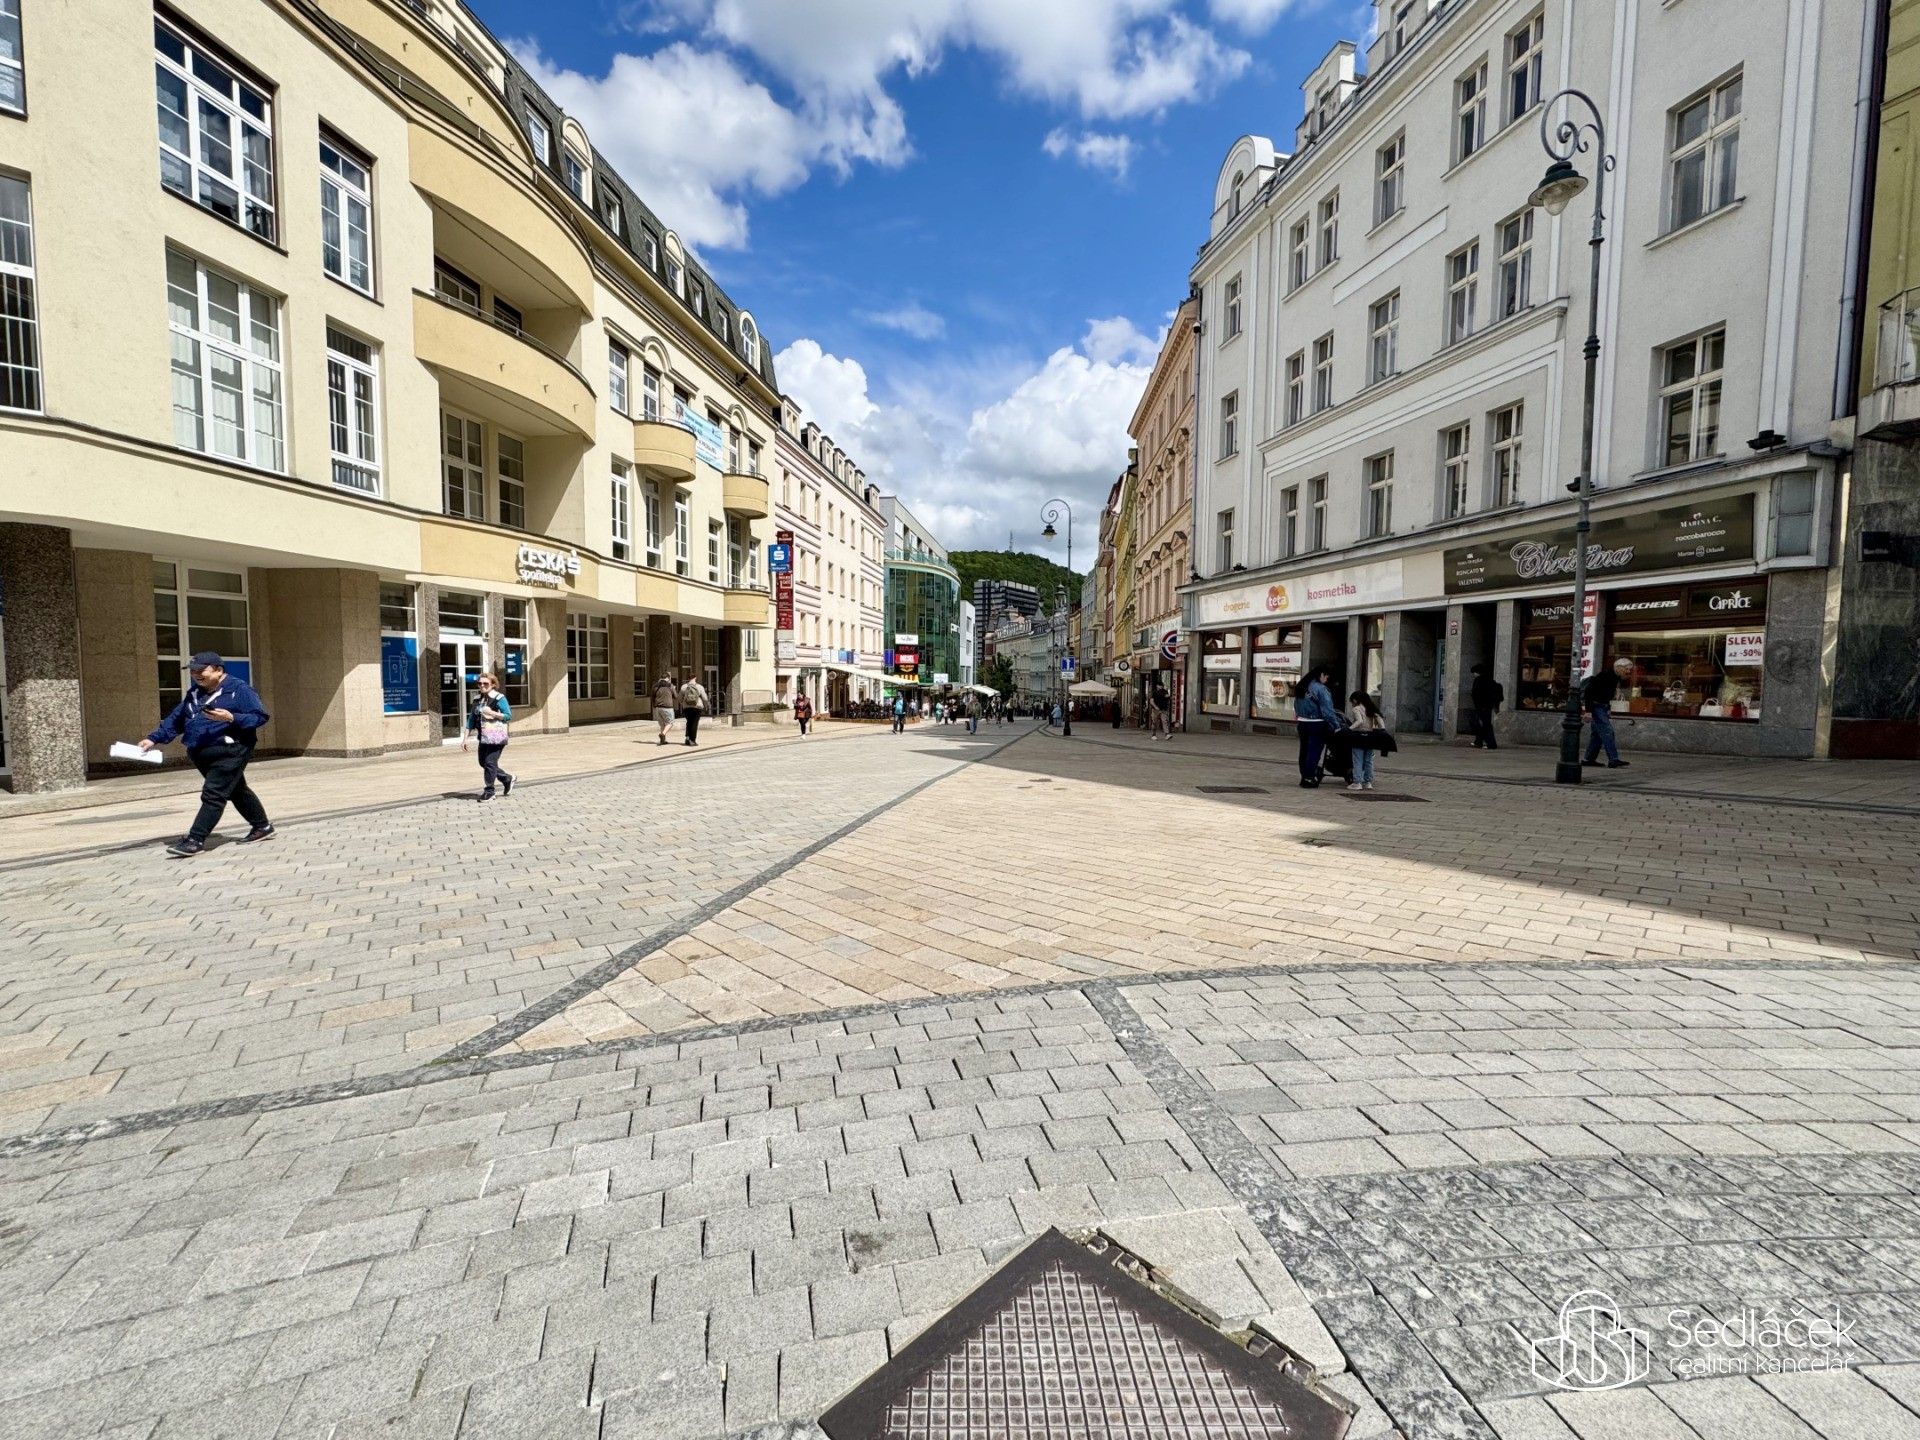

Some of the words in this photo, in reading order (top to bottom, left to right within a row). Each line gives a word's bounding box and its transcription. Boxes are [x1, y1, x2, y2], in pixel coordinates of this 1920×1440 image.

[1675, 530, 1726, 542] roccobarocco
[1509, 541, 1635, 579] Chrisina
[1307, 583, 1357, 600] kosmetika
[1615, 599, 1681, 611] SKECHERS
[1727, 636, 1762, 646] SLEVA
